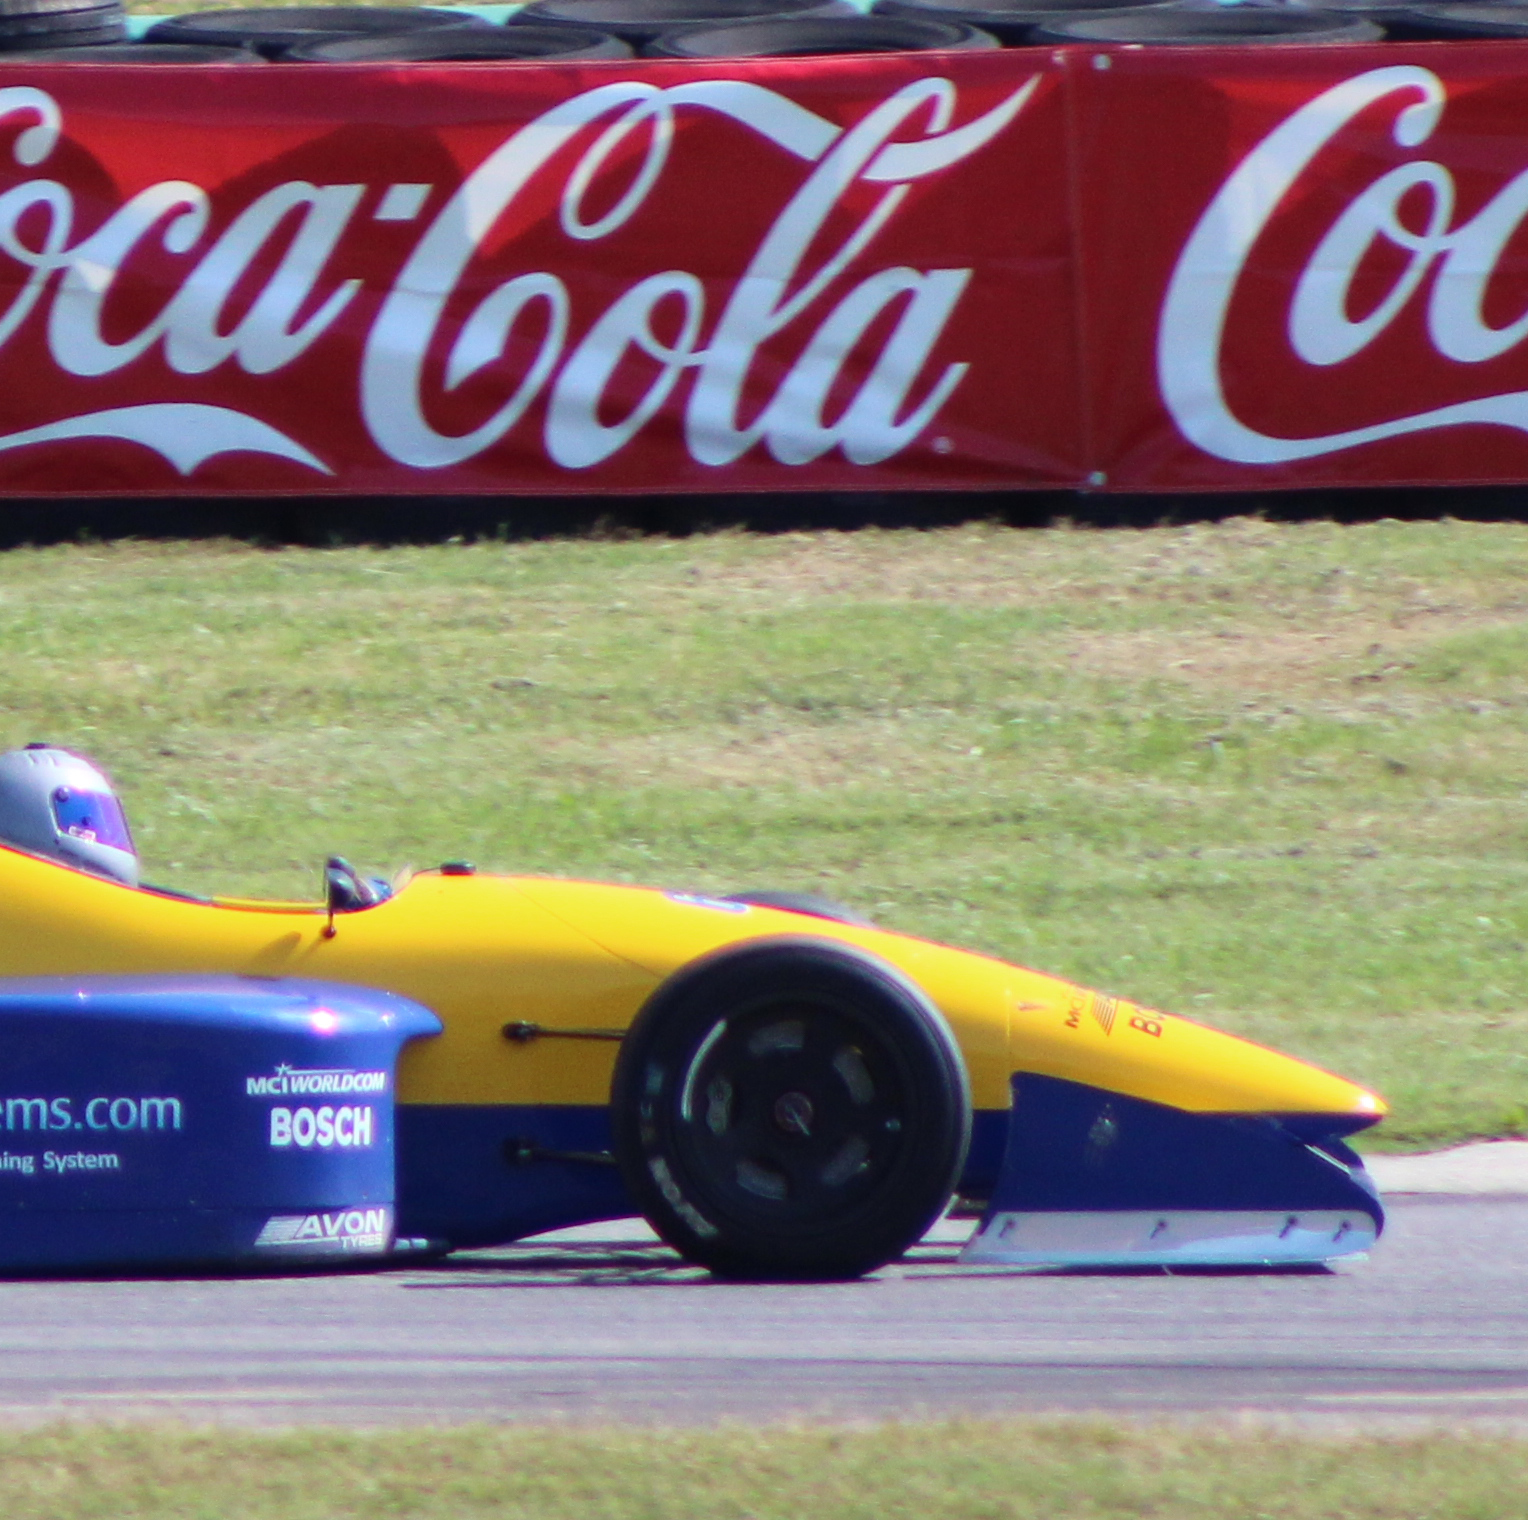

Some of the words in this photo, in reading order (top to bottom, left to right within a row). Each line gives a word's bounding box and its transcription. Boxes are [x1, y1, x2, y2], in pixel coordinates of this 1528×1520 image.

[270, 1106, 371, 1146] BOSCH
[42, 1151, 119, 1174] System
[294, 1208, 385, 1238] AVON
